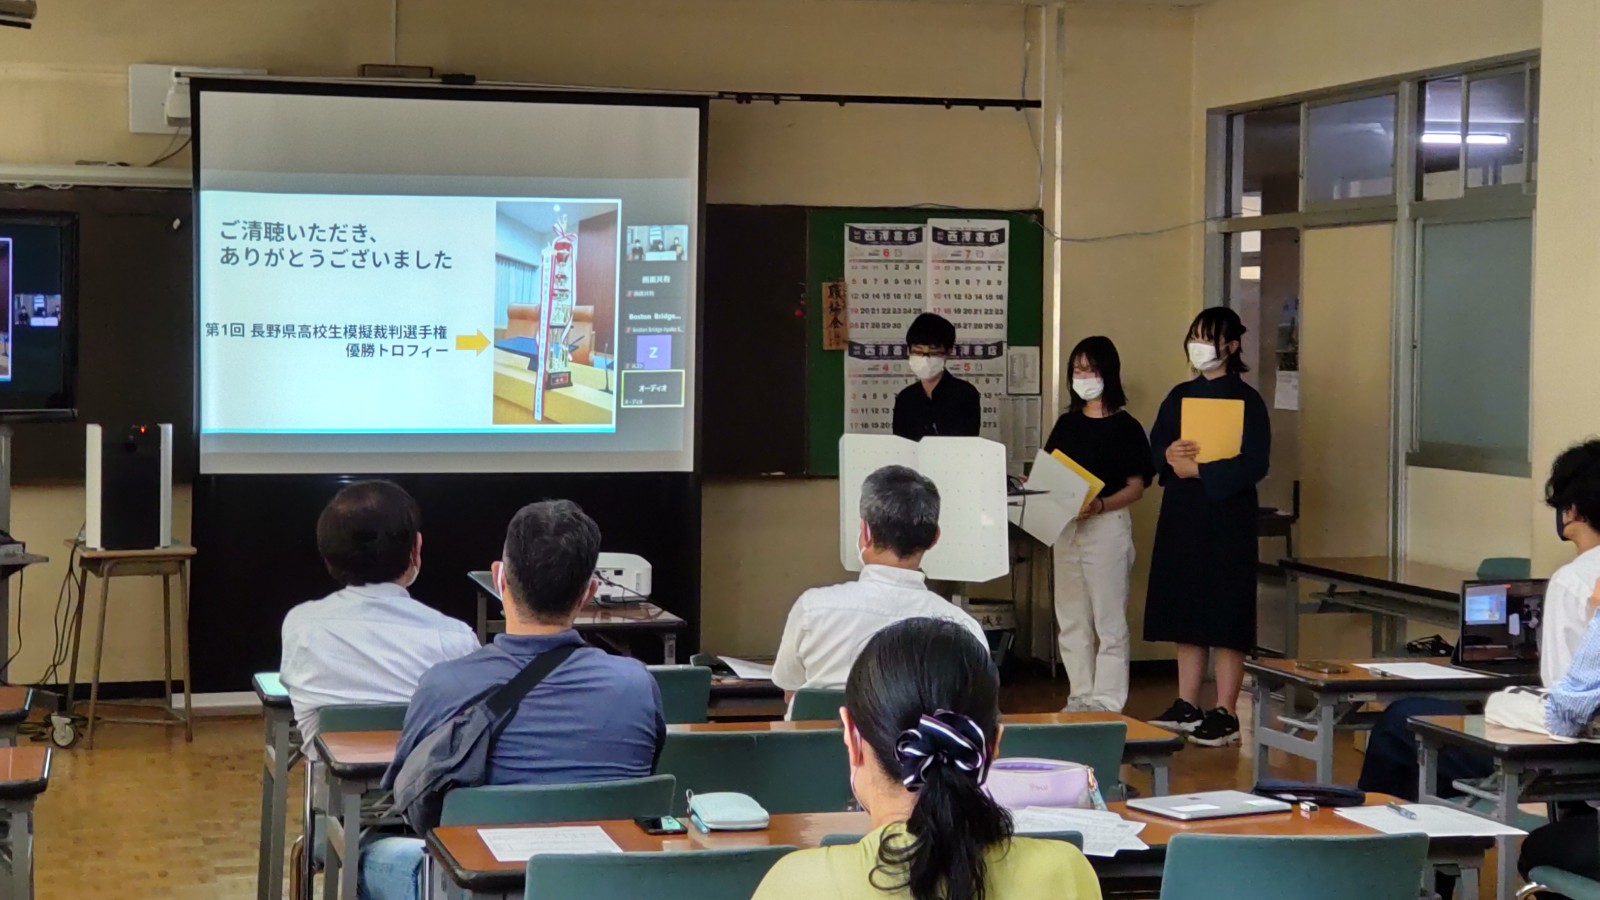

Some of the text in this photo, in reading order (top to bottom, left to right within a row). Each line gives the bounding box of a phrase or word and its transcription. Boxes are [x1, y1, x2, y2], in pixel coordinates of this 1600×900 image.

[220, 220, 378, 244] ご清聴いただき、
[219, 246, 453, 270] ありがとうございました
[205, 322, 448, 340] 第1回 長野県高校生模擬裁判選手権
[345, 343, 449, 359] 優勝トロフィー
[648, 346, 658, 358] Z
